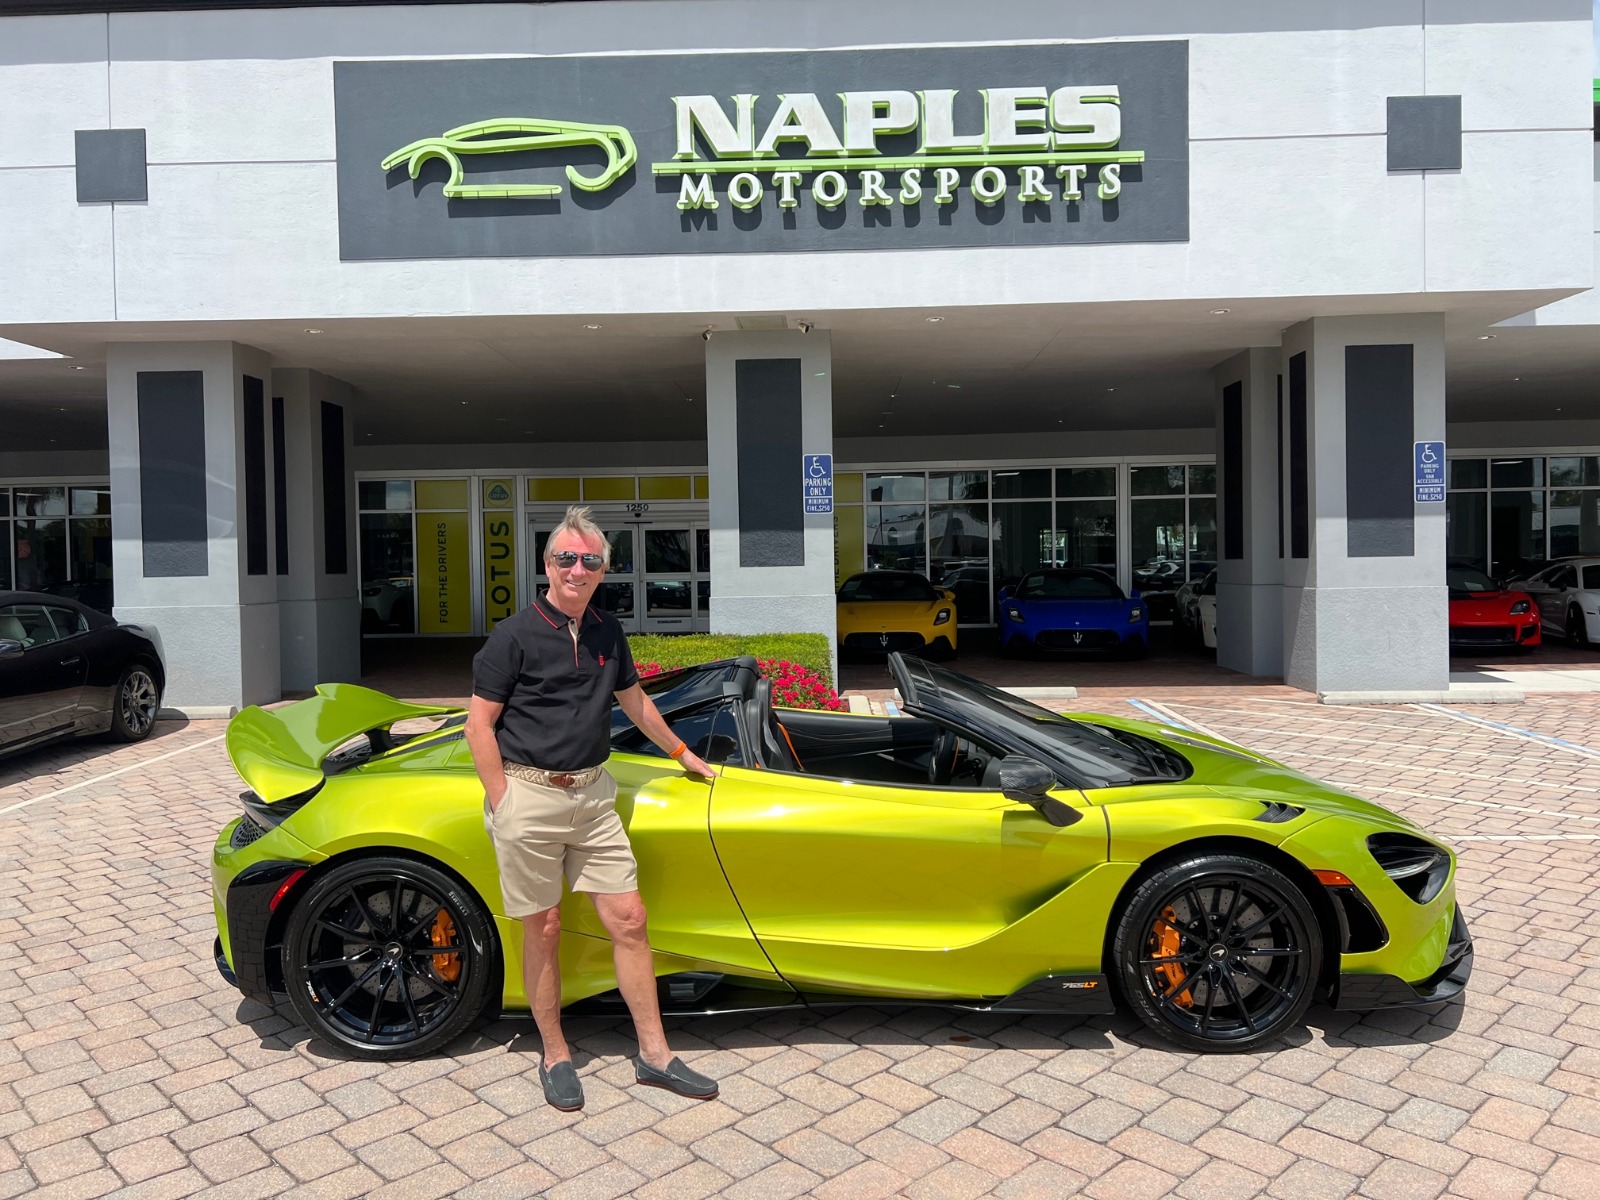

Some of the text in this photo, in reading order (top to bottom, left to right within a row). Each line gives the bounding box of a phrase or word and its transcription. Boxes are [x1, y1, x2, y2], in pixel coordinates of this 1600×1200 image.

[670, 84, 1121, 159] NAPLES
[676, 163, 1121, 210] MOTORSPORTS
[805, 477, 832, 487] PARKING
[810, 487, 827, 496] ONLY
[625, 503, 649, 512] 1250
[437, 522, 448, 623] FOR THE DRIVERS
[490, 521, 511, 623] LOTUS
[1062, 981, 1098, 989] 765LT
